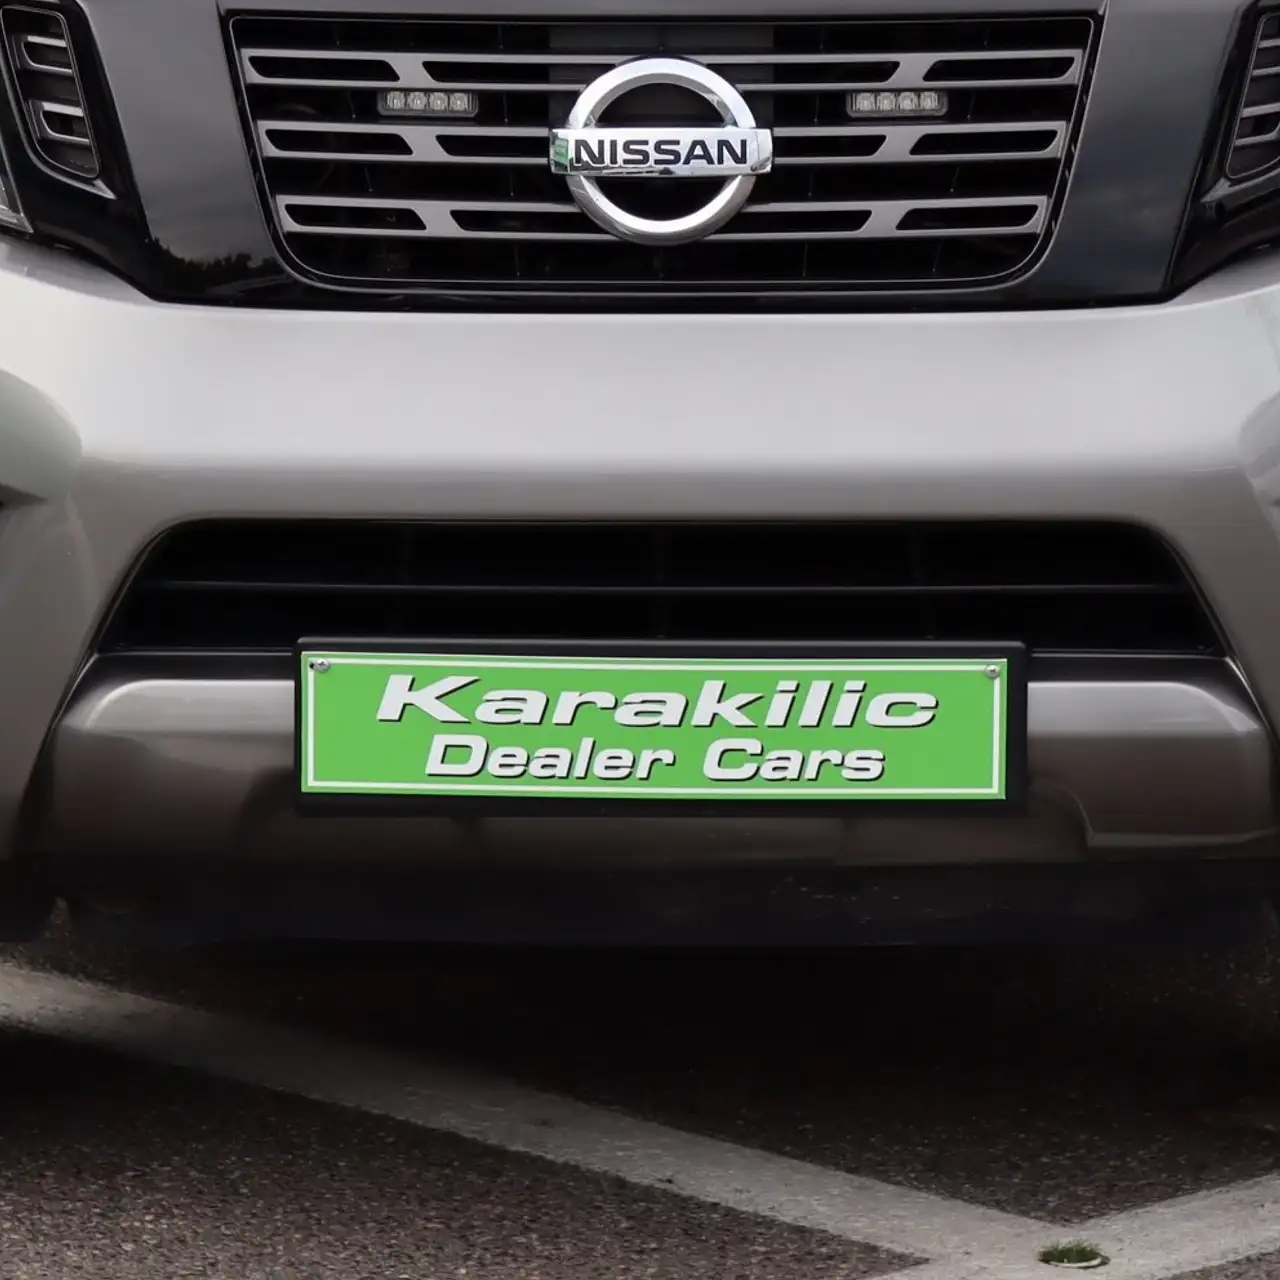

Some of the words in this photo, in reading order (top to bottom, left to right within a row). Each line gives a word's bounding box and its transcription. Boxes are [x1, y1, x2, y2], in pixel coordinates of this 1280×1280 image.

[573, 139, 748, 166] NISSAN
[375, 673, 939, 728] Karakilic
[424, 733, 676, 780] Dealer
[702, 737, 886, 782] Cars
